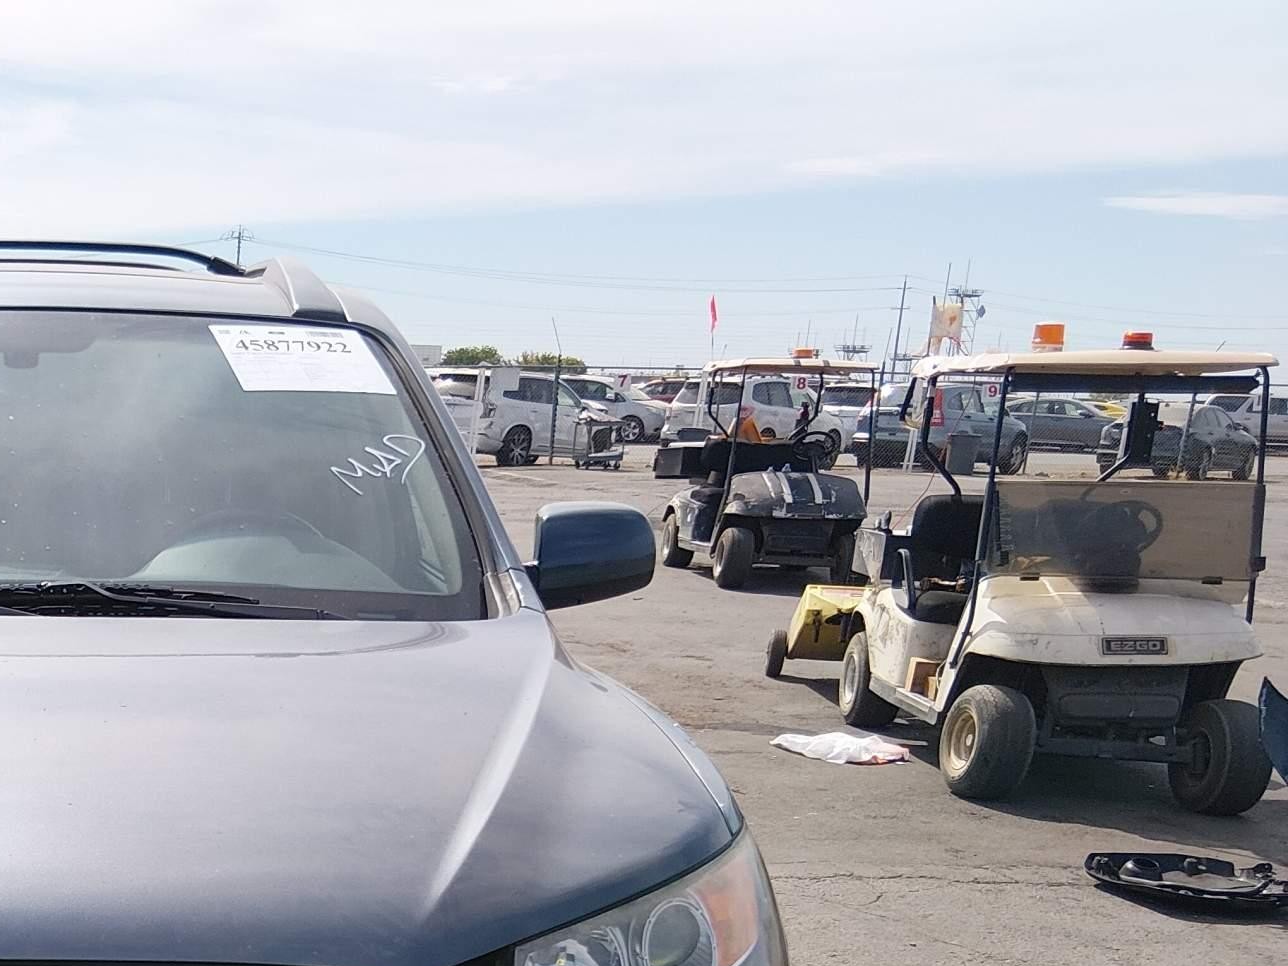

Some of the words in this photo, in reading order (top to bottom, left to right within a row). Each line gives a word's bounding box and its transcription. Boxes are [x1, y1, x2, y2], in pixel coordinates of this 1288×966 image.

[235, 338, 352, 354] 45877922
[617, 375, 627, 387] 7
[797, 377, 806, 389] 8
[988, 385, 998, 397] 9
